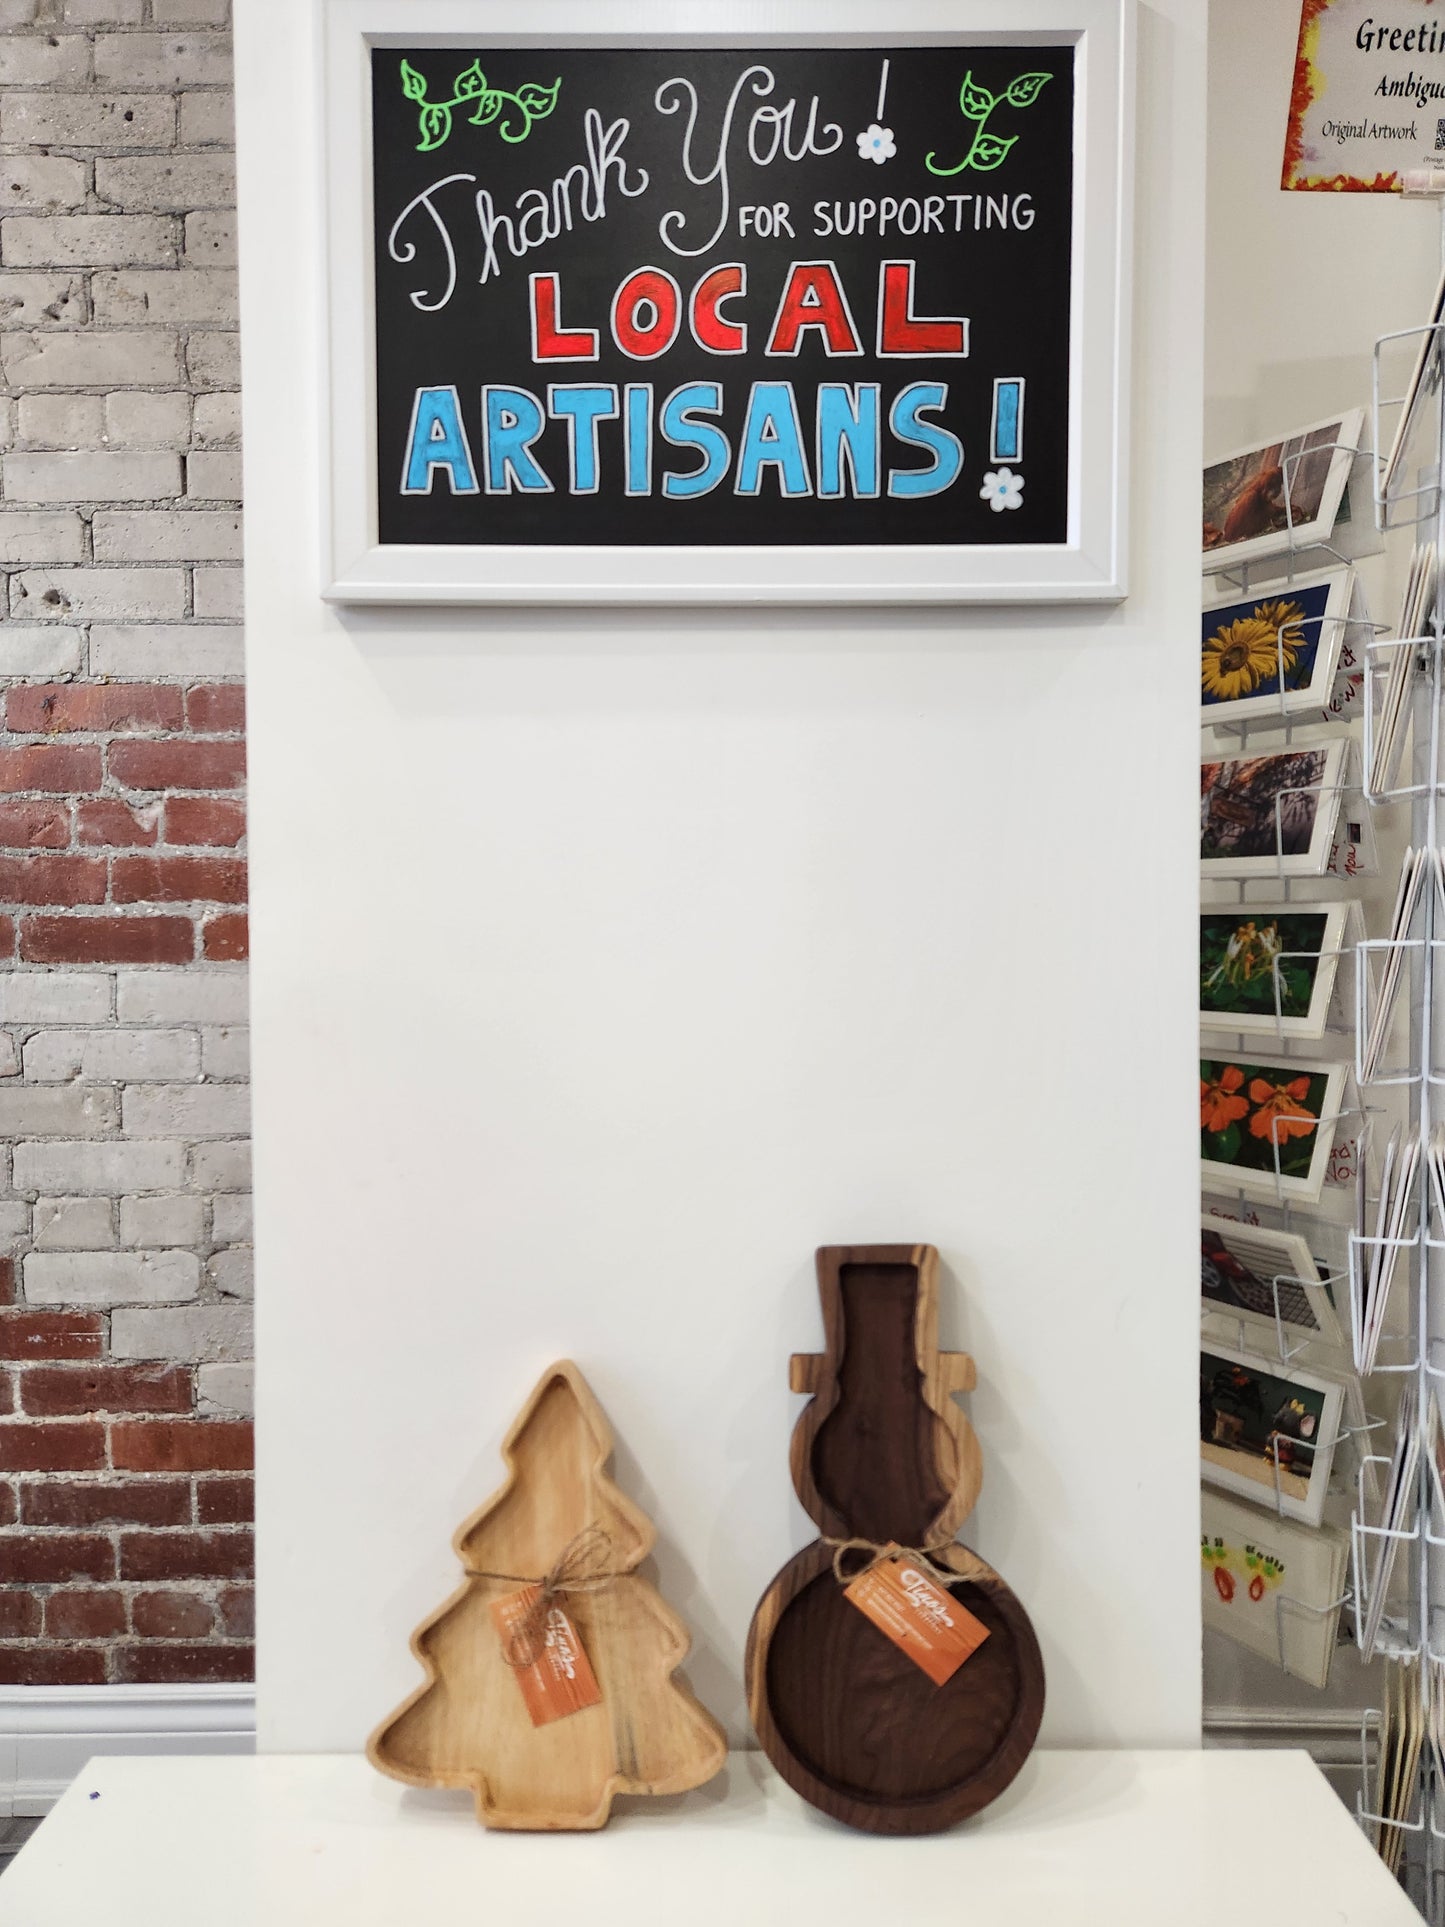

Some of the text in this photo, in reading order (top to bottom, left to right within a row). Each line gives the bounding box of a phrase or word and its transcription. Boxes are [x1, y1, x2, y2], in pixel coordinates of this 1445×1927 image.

[1322, 118, 1418, 144] Original Artwork
[388, 108, 649, 312] Thank
[738, 192, 1036, 239] FOR SUPPORTING
[529, 259, 969, 363] LOCAL
